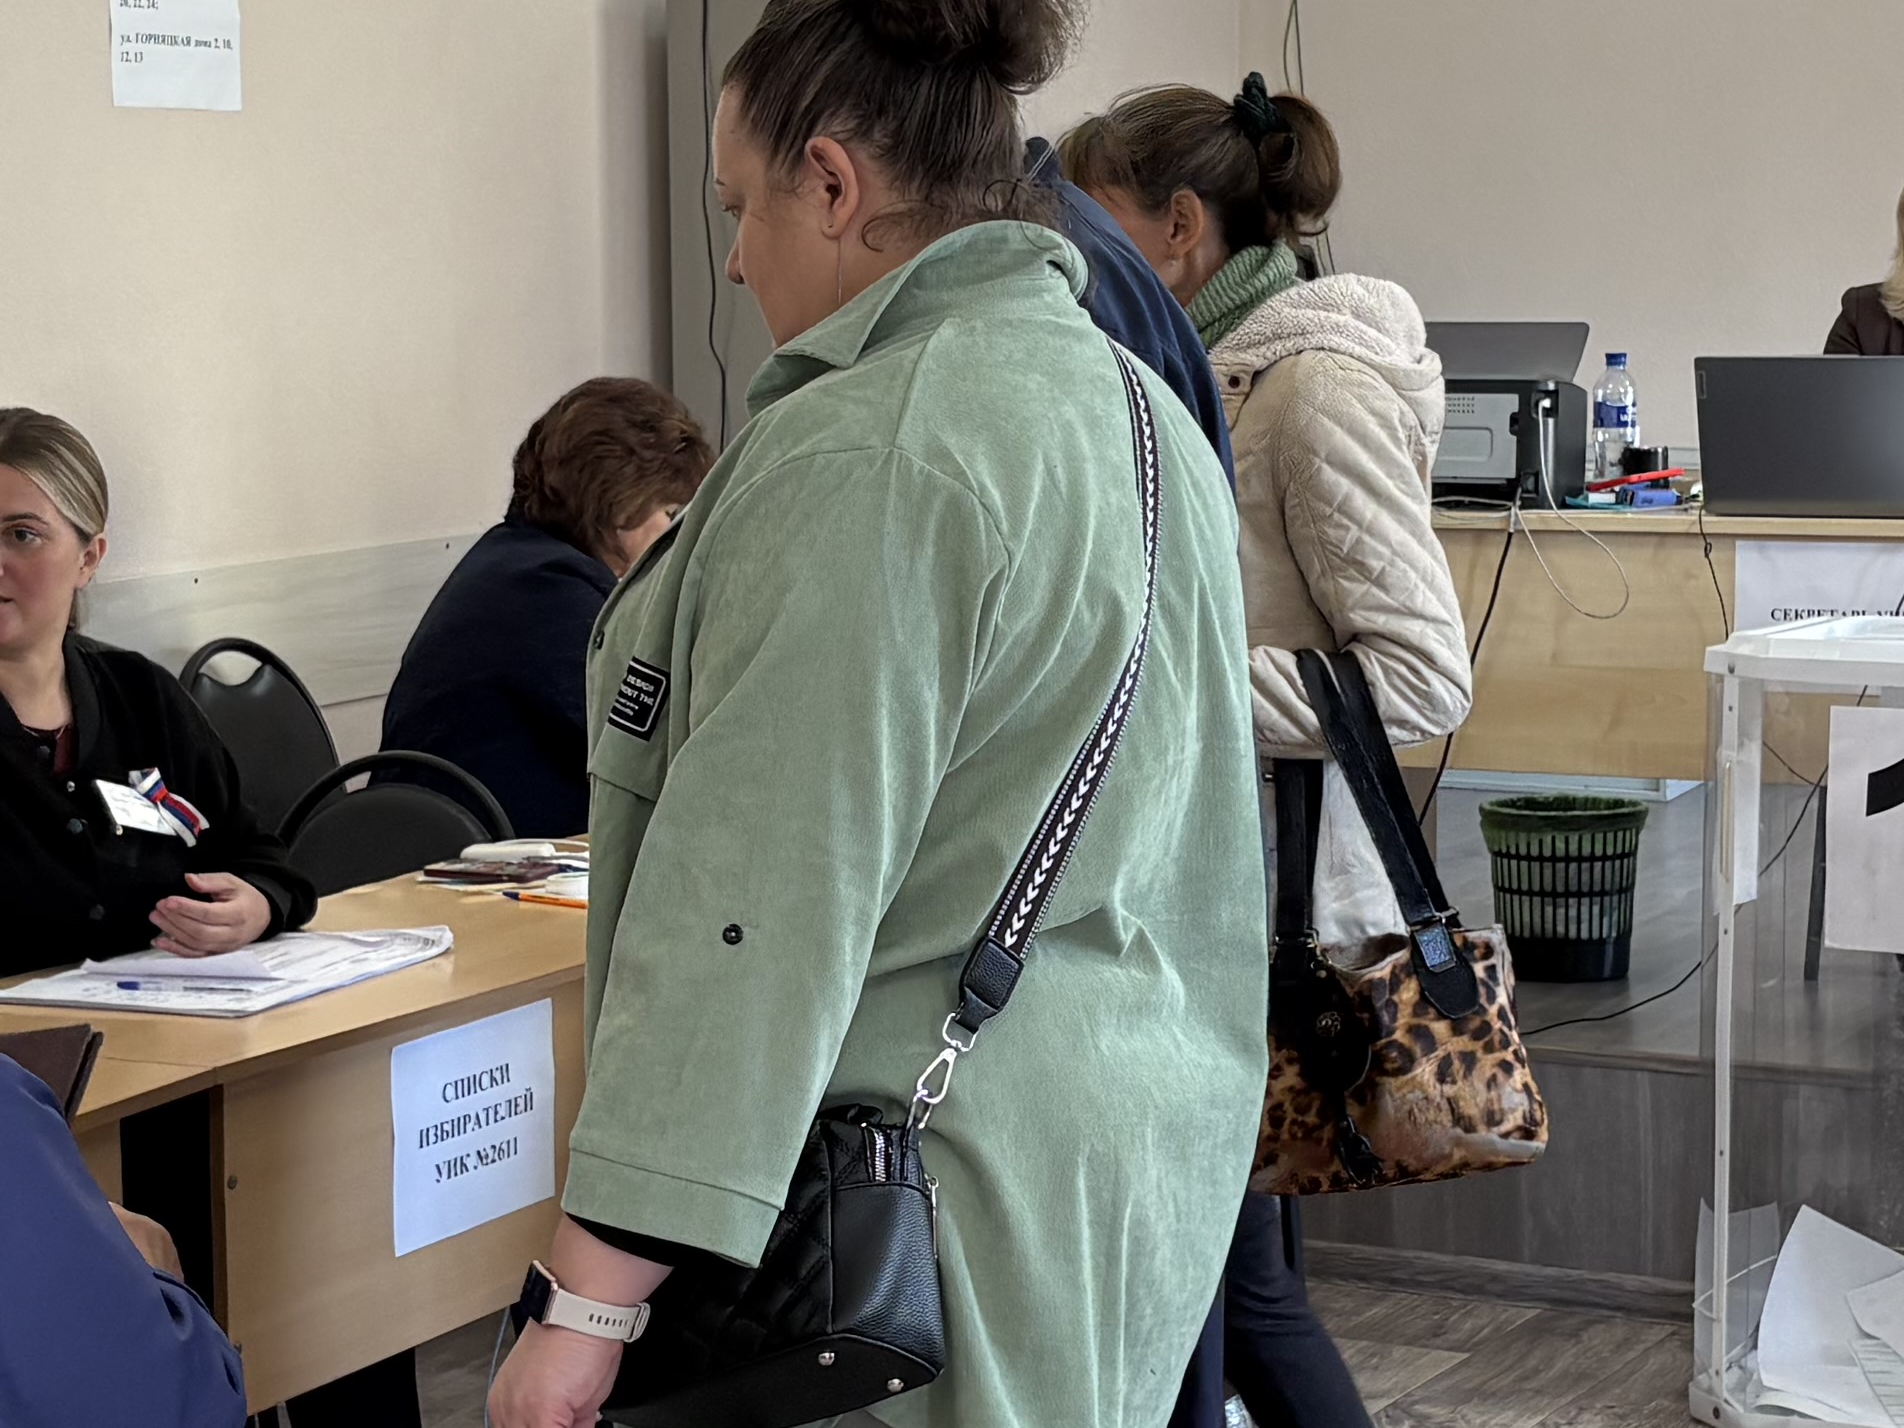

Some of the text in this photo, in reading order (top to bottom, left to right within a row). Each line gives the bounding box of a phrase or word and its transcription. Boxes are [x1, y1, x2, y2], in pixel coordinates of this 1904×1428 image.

[442, 1062, 511, 1103] СПИСКИ
[418, 1087, 535, 1149] ИЗБИРАТЕЛЕЙ
[434, 1136, 519, 1183] УИК №2611
